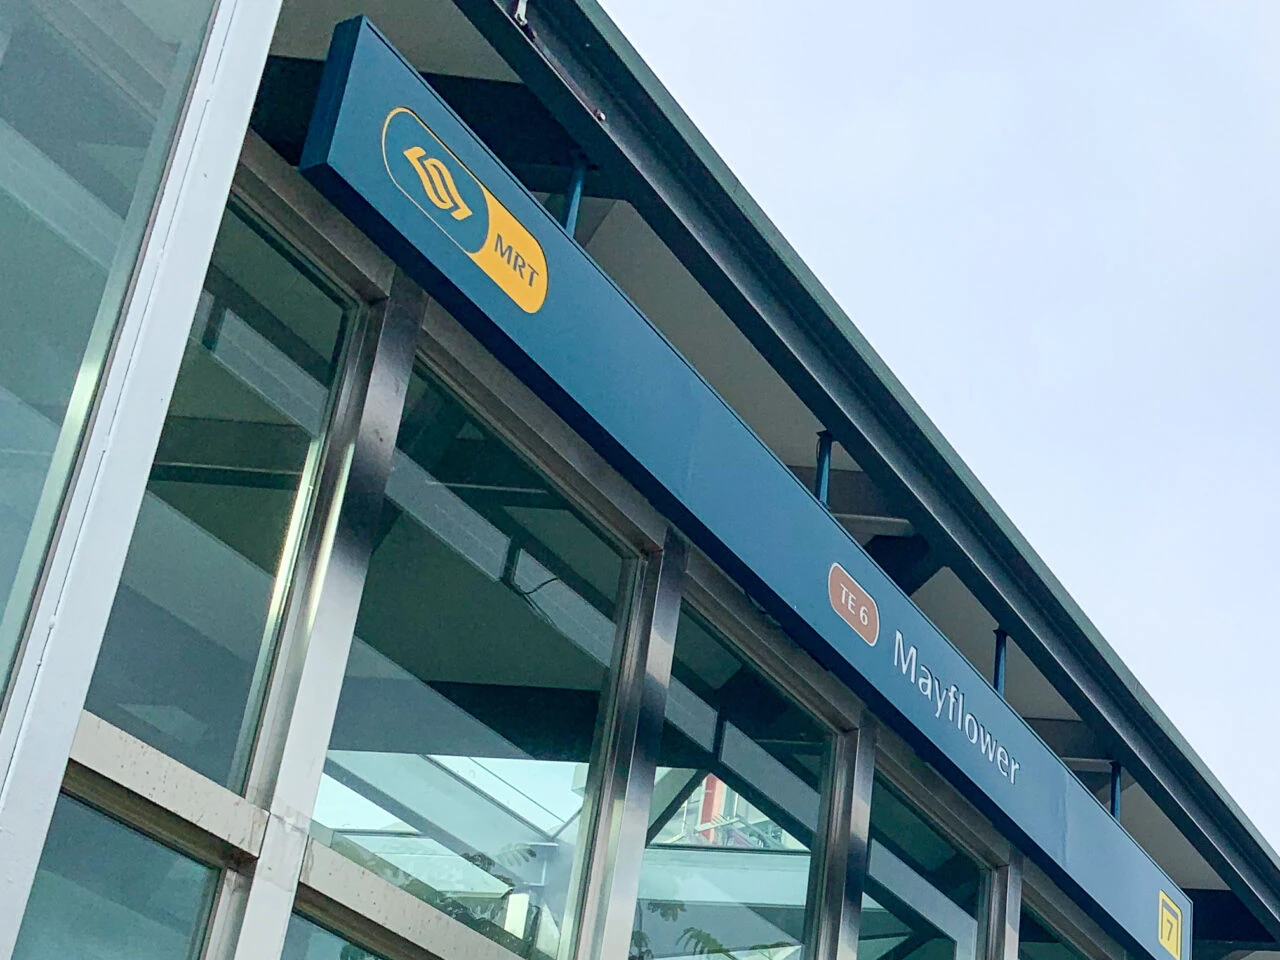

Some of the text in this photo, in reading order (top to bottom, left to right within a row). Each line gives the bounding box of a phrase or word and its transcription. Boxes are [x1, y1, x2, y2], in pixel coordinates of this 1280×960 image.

[494, 233, 539, 287] MRT
[840, 583, 869, 626] TE 6
[893, 630, 1021, 785] Mayflower
[1166, 918, 1174, 941] 7
